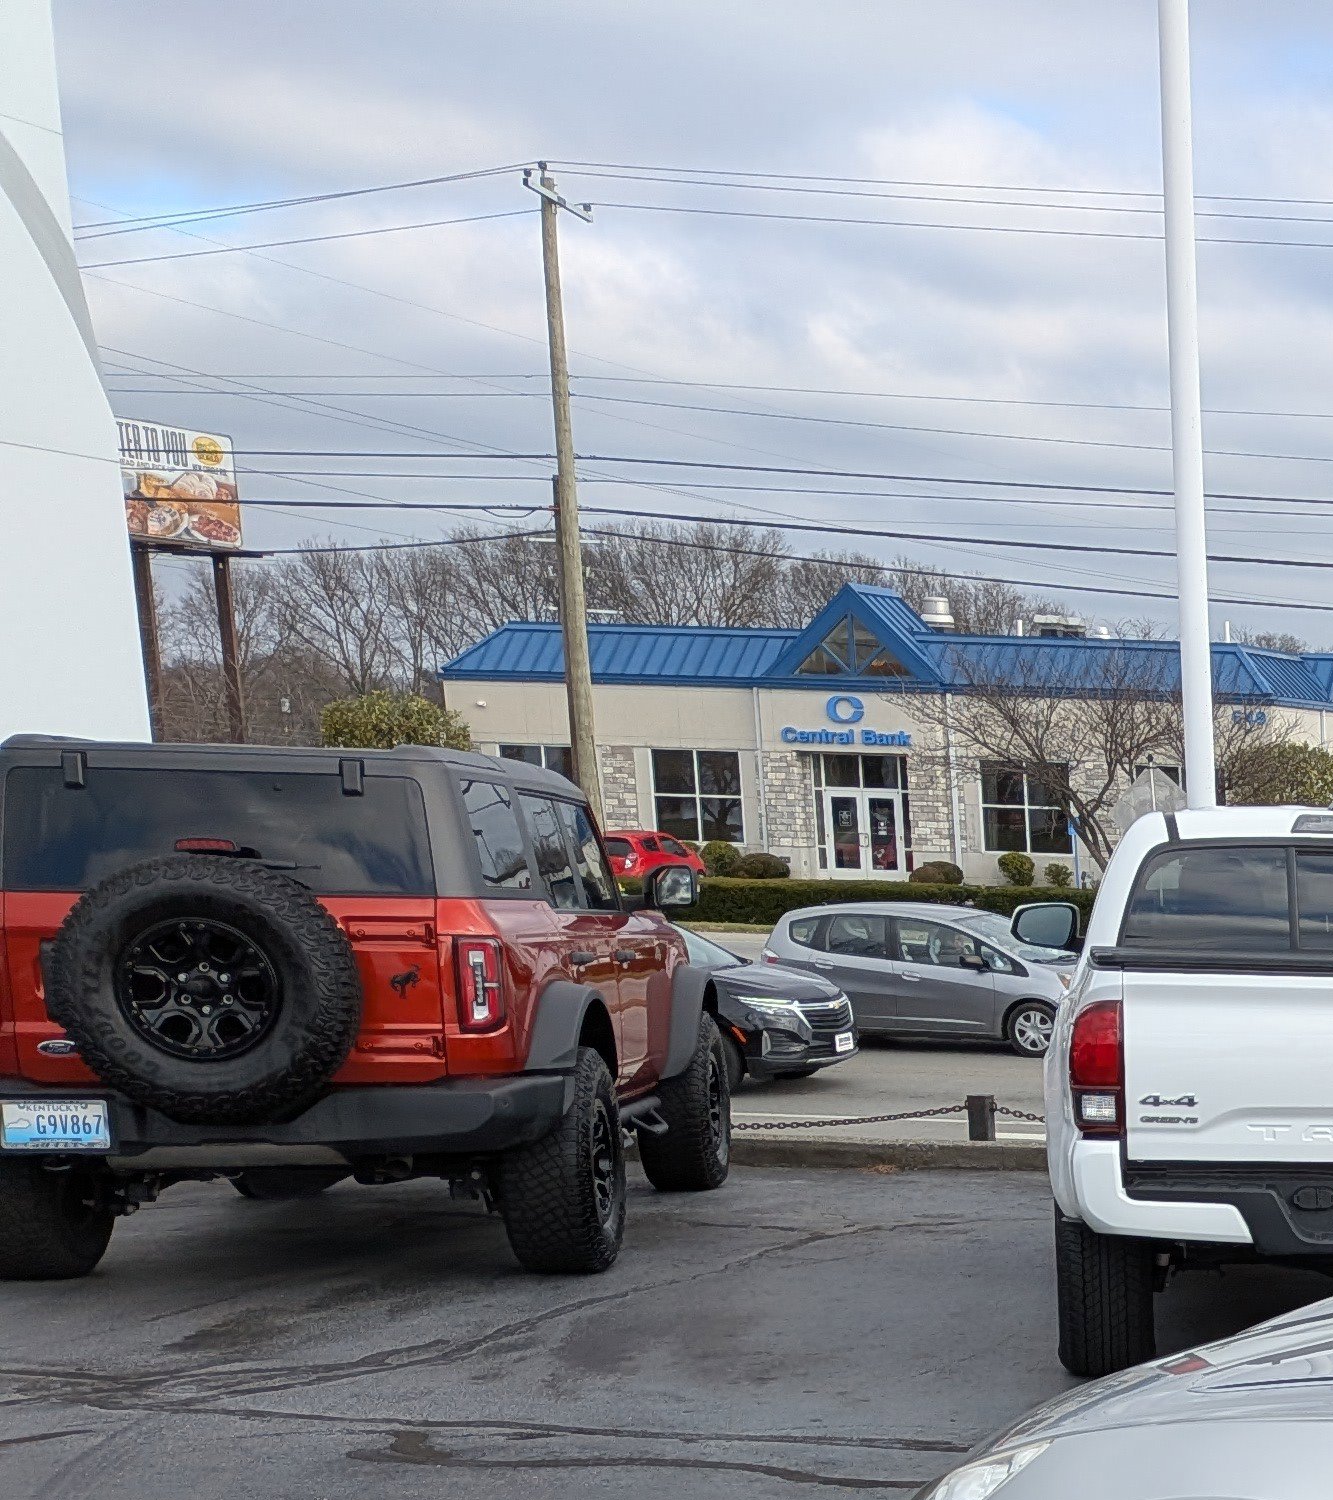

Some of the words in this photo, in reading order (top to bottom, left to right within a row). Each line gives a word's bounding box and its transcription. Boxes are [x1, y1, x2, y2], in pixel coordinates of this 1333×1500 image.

[143, 426, 160, 462] TO
[161, 429, 188, 467] YOU
[781, 727, 854, 745] Central
[861, 729, 912, 746] Bank
[47, 1043, 71, 1053] Ford
[26, 1104, 79, 1112] KENTUCKY
[36, 1114, 102, 1135] G9V867
